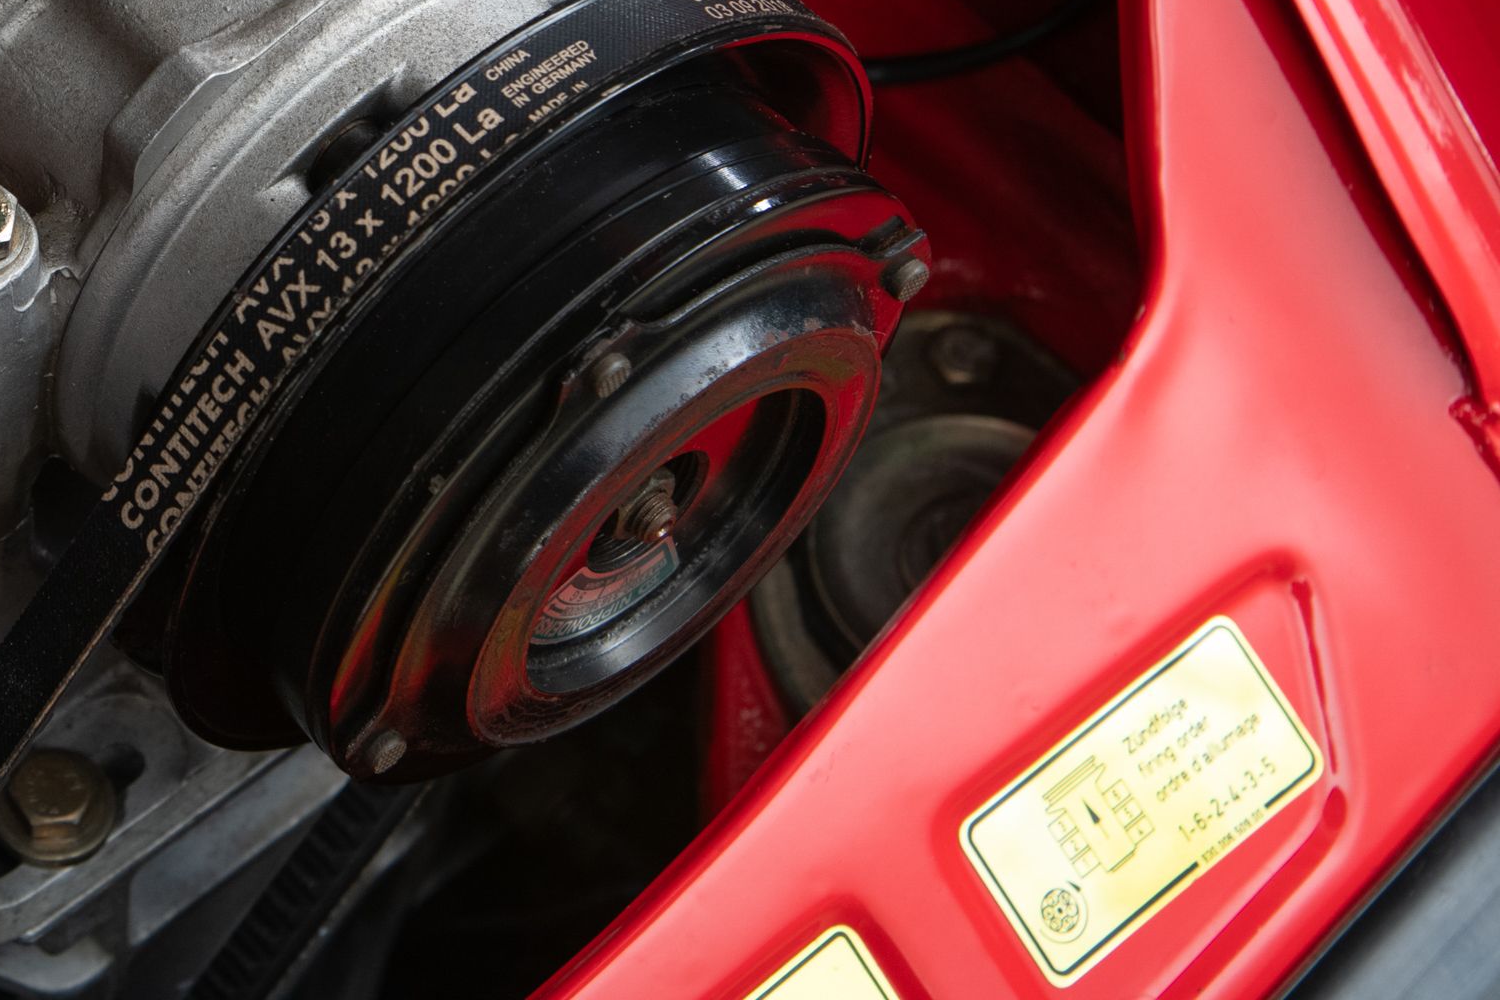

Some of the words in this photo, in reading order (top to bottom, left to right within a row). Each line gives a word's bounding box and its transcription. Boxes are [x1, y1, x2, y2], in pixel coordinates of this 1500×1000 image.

[704, 3, 734, 19] 03
[729, 0, 756, 14] 09
[485, 49, 532, 82] CHINA
[501, 40, 589, 99] ENGINEERED
[511, 91, 532, 109] IN
[530, 49, 598, 95] GERMANY
[528, 92, 568, 123] MADE
[570, 79, 590, 96] IN
[120, 348, 256, 530] CONTITECH
[255, 268, 322, 352] AVX
[315, 230, 358, 272] 13
[354, 208, 385, 238] x
[380, 137, 458, 207] 1200
[451, 107, 506, 145] La
[1122, 699, 1188, 754] Zündfolge
[1137, 746, 1177, 776] firing
[1177, 716, 1208, 748] order
[1156, 771, 1190, 802] ordre
[1178, 756, 1276, 842] 1-6-2-4-3-5
